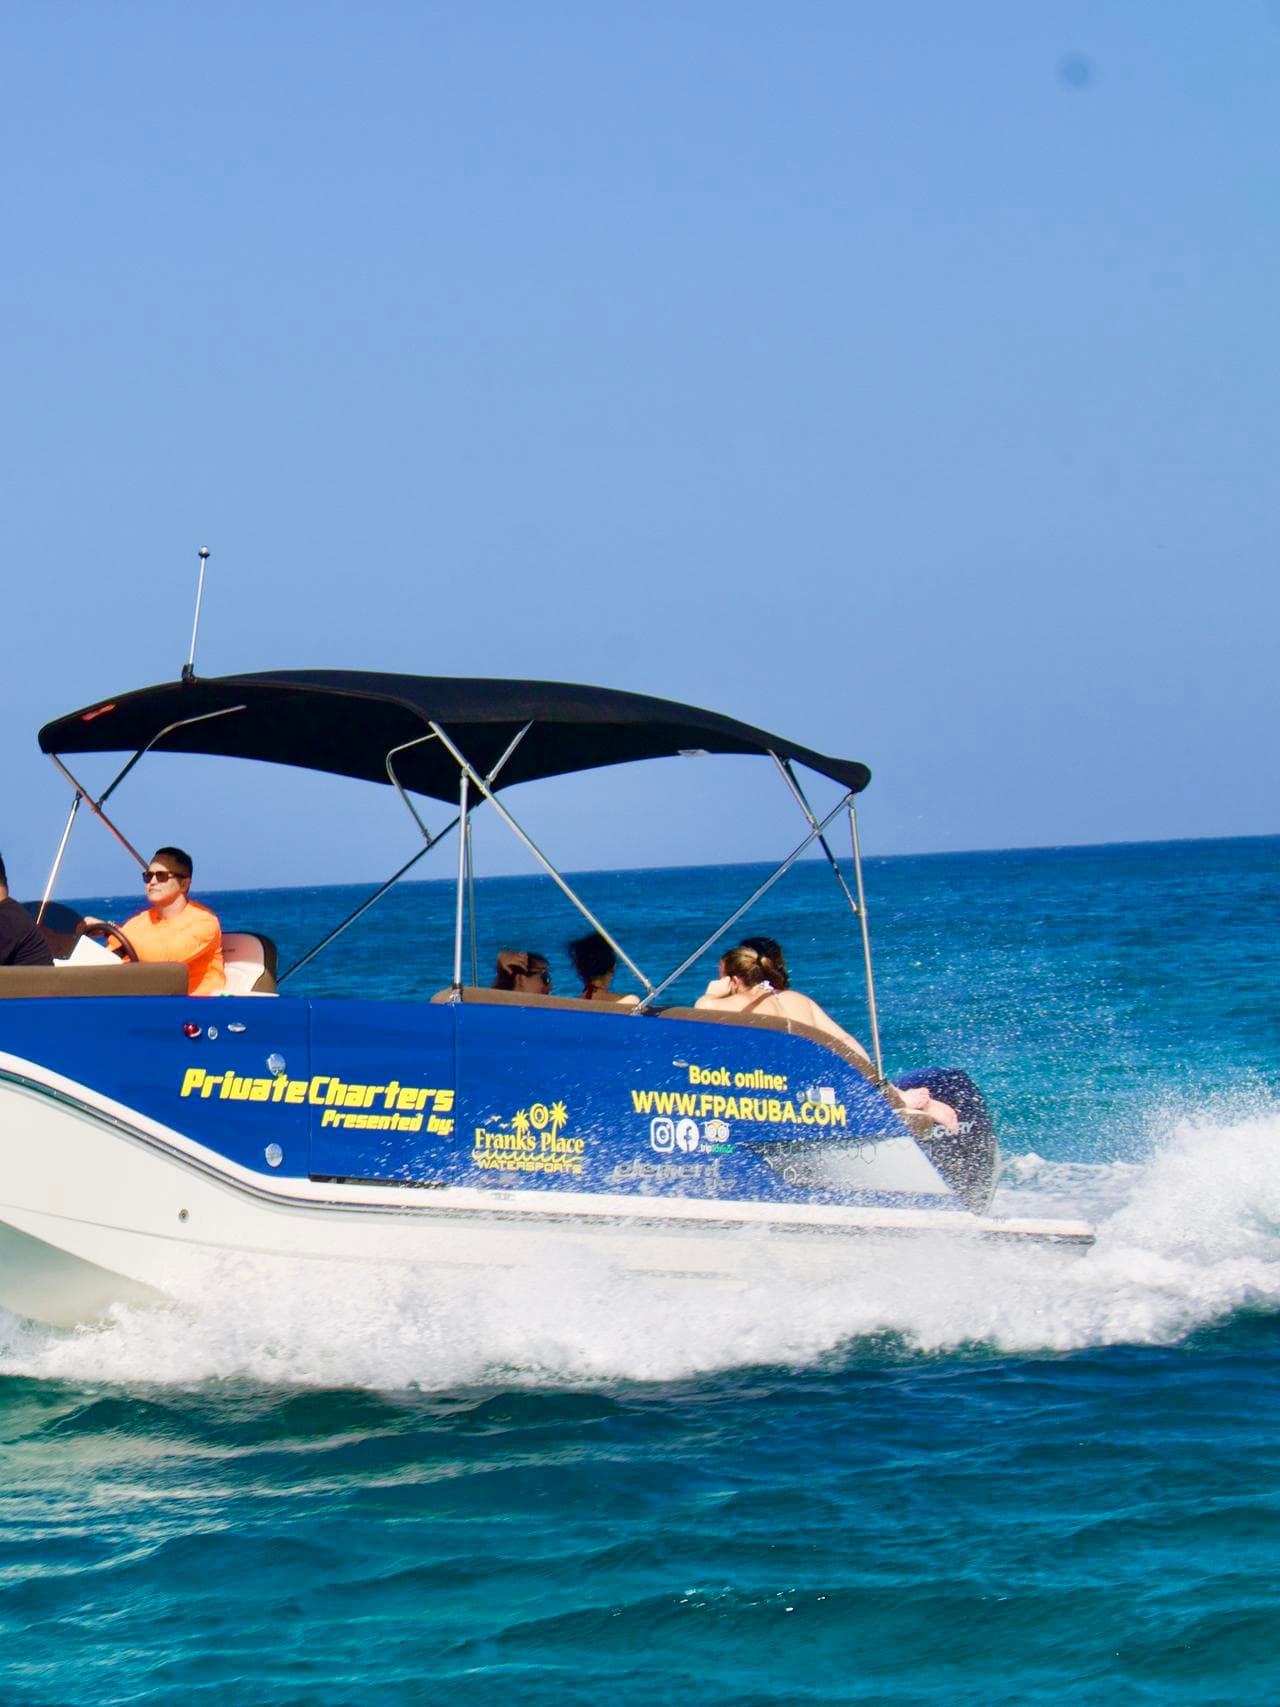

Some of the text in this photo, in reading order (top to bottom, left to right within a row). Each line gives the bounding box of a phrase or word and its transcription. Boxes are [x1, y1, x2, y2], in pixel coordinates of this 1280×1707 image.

[689, 1065, 788, 1091] Book online:
[321, 1109, 424, 1132] Presented
[631, 1089, 847, 1127] WWW.FPARUBA.COM
[475, 1127, 585, 1154] Frank's Place
[478, 1159, 582, 1175] WATERSPORTS
